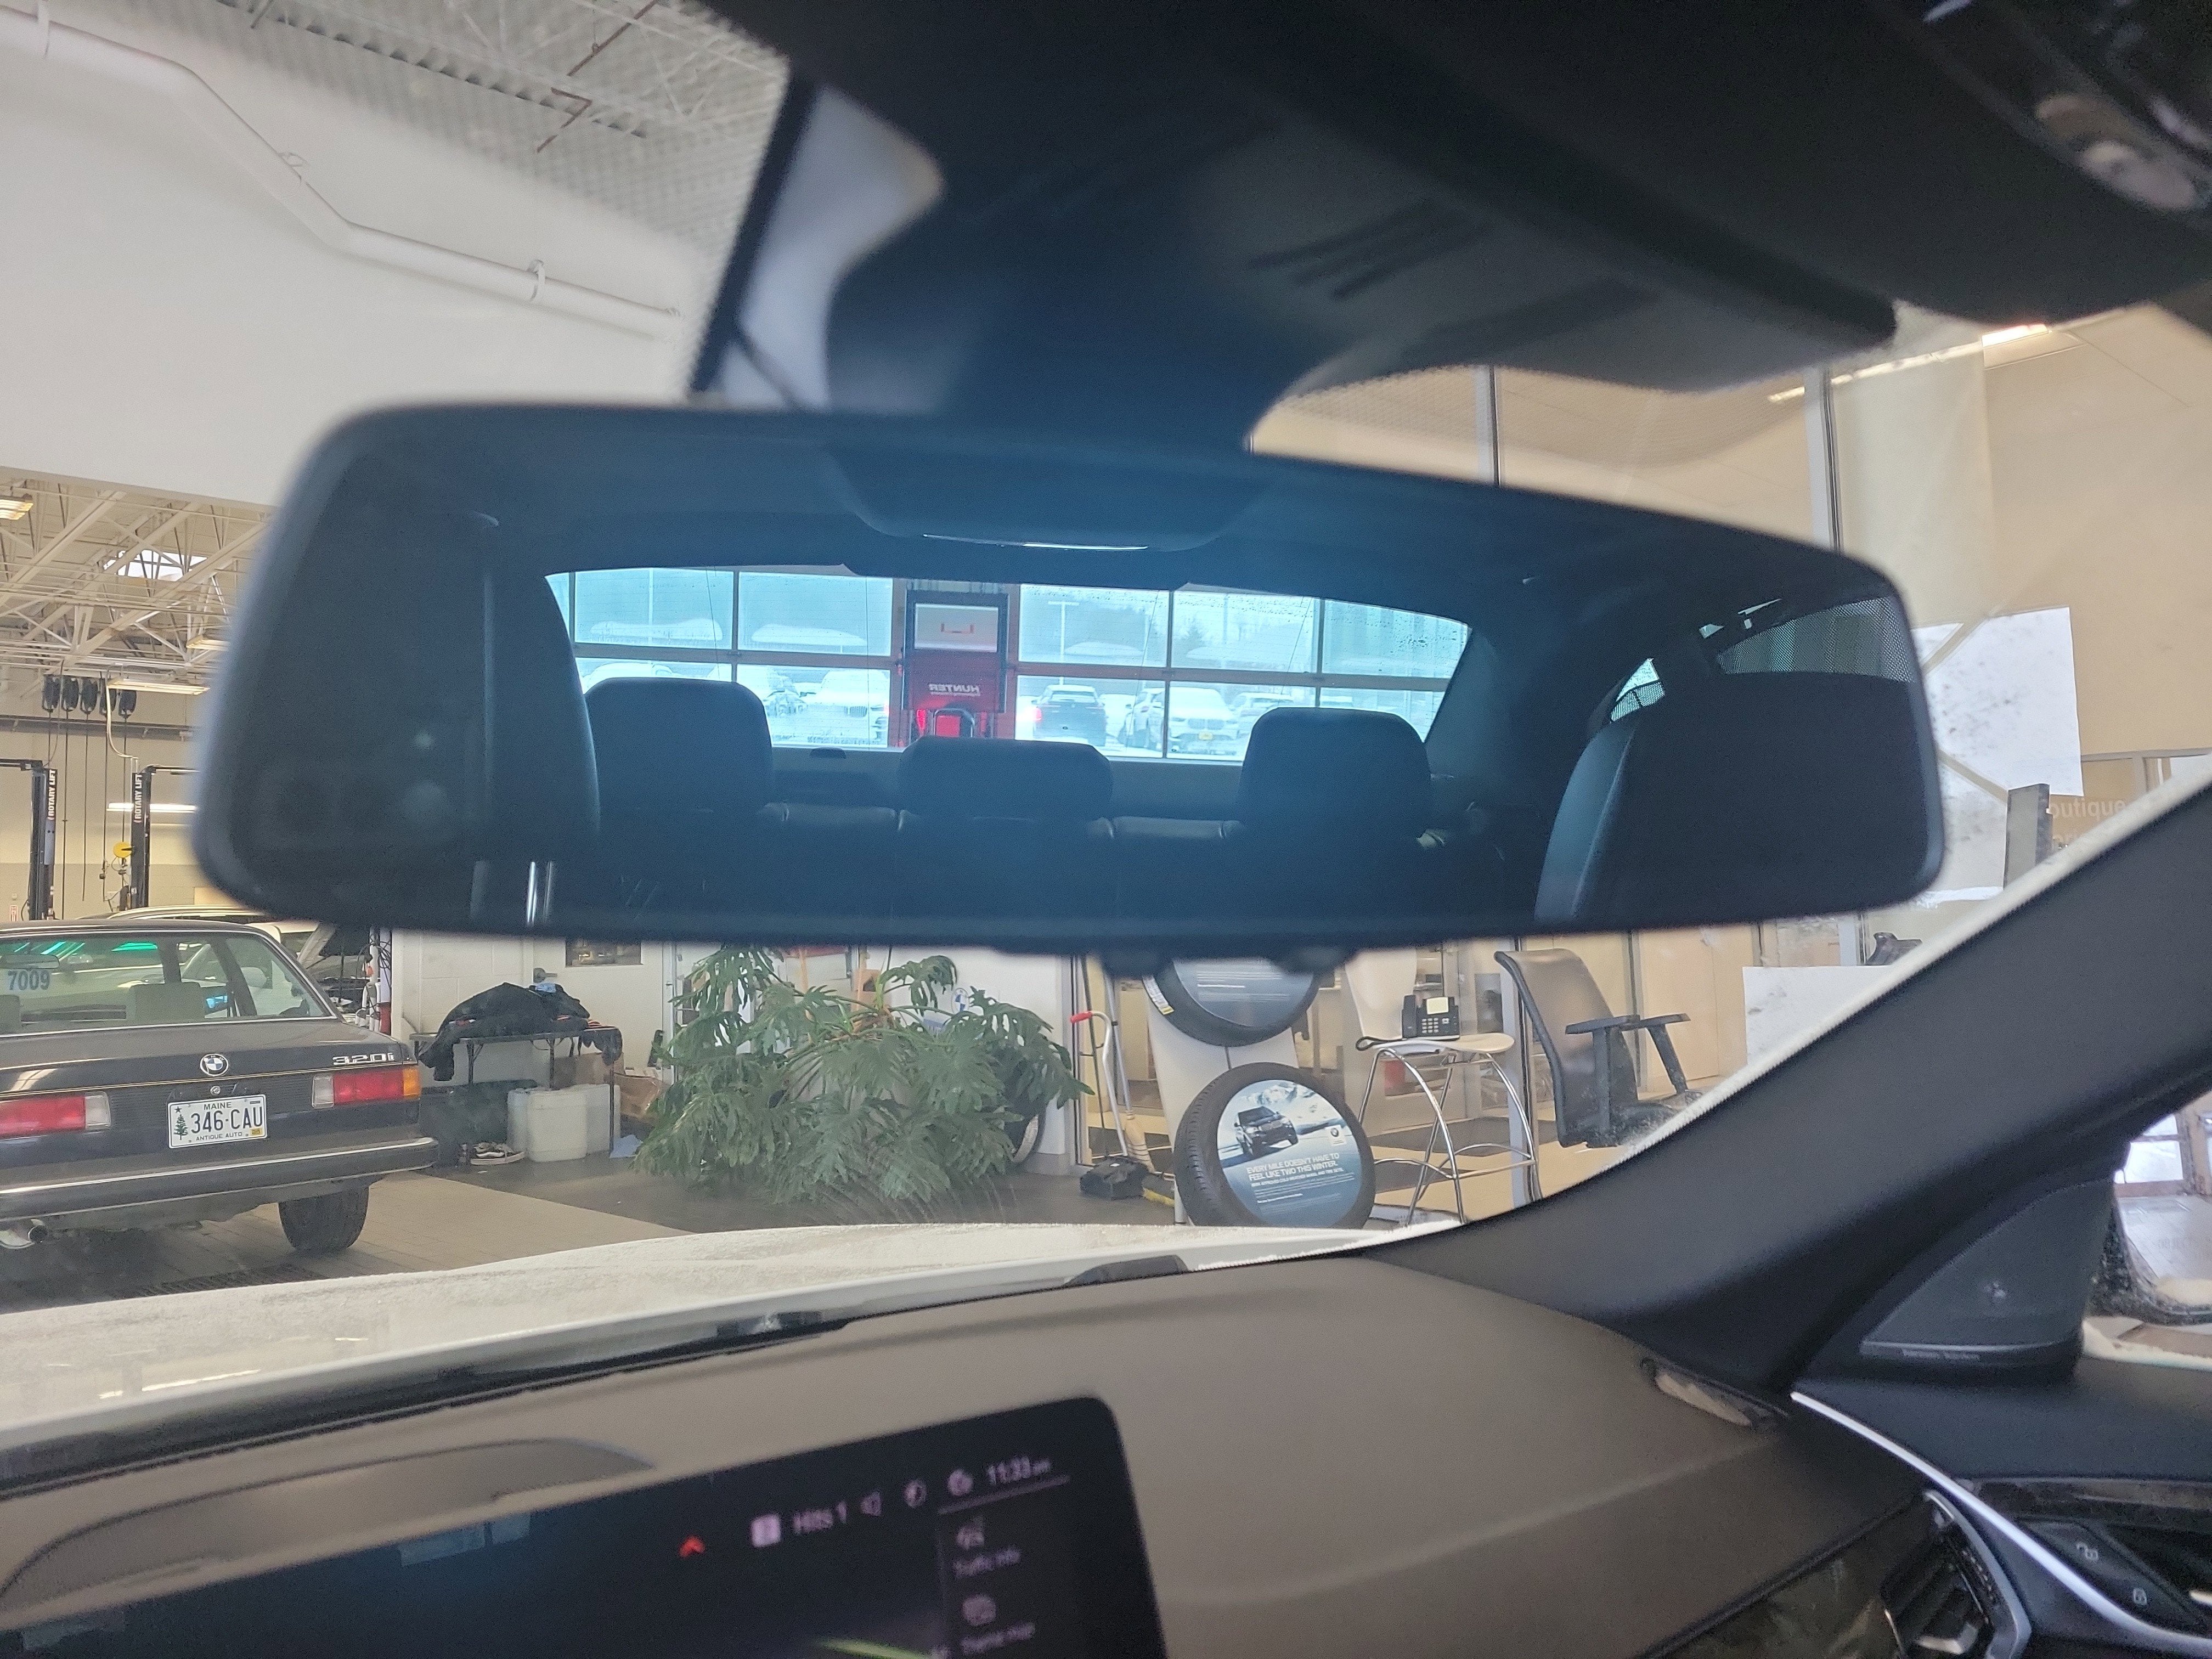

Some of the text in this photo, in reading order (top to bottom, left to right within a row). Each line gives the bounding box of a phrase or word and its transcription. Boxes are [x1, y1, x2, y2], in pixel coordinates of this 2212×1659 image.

[7, 969, 50, 990] 7009
[332, 1052, 396, 1066] 320i
[204, 1102, 232, 1110] MAINE
[1246, 1164, 1267, 1174] EVERY
[1267, 1161, 1285, 1171] MILE
[1313, 1154, 1330, 1163] HAVE
[1249, 1172, 1266, 1181] FEEL
[1265, 1169, 1281, 1178] LIKE
[1280, 1167, 1296, 1176] TWO
[1296, 1164, 1312, 1173] THIS
